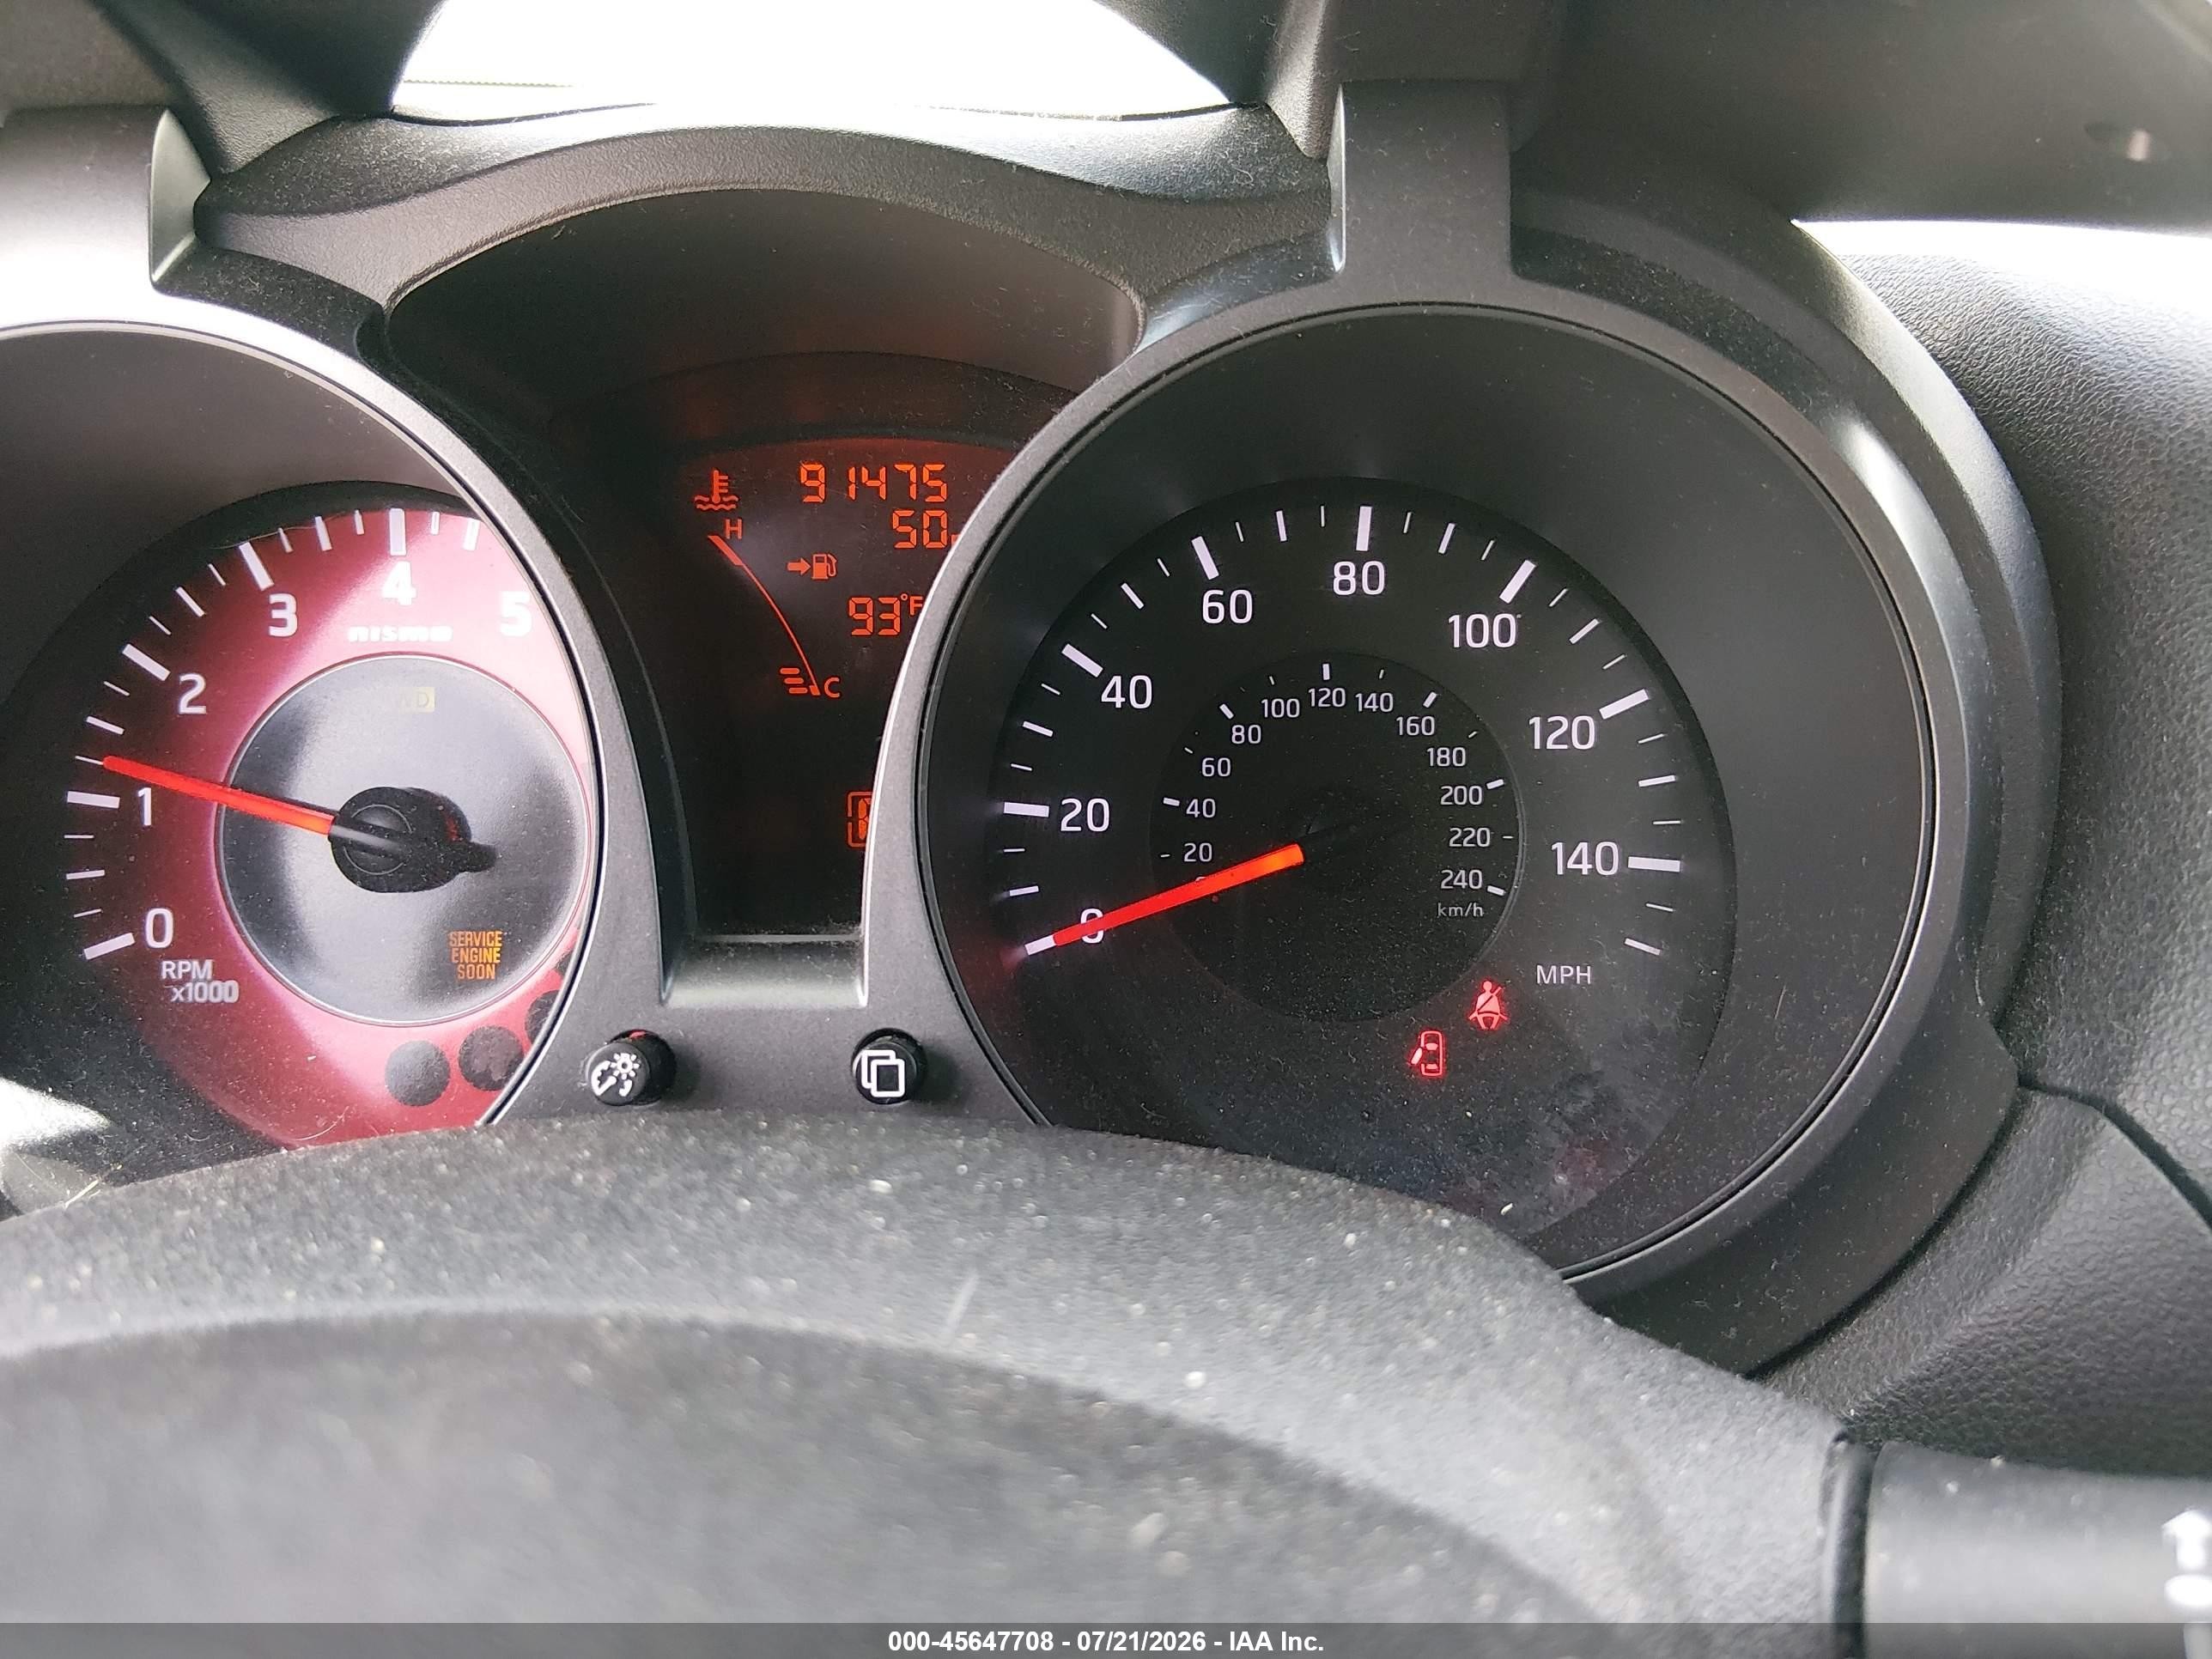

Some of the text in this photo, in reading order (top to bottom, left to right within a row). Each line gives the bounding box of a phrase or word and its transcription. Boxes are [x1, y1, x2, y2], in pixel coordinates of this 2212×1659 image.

[799, 462, 947, 502] 91475
[725, 519, 743, 539] H
[380, 561, 417, 606] 4
[1333, 560, 1385, 596] 80
[269, 593, 298, 637] 3
[500, 591, 532, 637] 5
[1202, 589, 1253, 624] 60
[1448, 613, 1516, 648] 100
[179, 673, 208, 715] 2
[823, 677, 840, 698] C
[1101, 675, 1152, 709] 40
[1308, 687, 1346, 708] 120
[1261, 698, 1300, 718] 100
[1355, 692, 1394, 713] 140
[1231, 724, 1261, 744] 80
[1396, 715, 1435, 736] 160
[1528, 715, 1595, 750] 120
[1201, 757, 1231, 777] 60
[1426, 746, 1466, 767] 180
[1440, 785, 1483, 805] 200
[137, 787, 152, 826] 1
[1060, 798, 1109, 832] 20
[1186, 798, 1216, 818] 40
[1449, 827, 1491, 848] 220
[1183, 842, 1212, 862] 20
[1551, 841, 1620, 876] 140
[1441, 869, 1483, 890] 240
[1437, 902, 1485, 917] km/h
[145, 908, 173, 949] 0
[449, 930, 503, 947] SERVICE
[452, 947, 501, 964] ENGINE
[161, 959, 213, 981] RPM
[457, 963, 495, 980] SOON
[1536, 964, 1591, 985] MPH
[170, 979, 240, 1004] x1000
